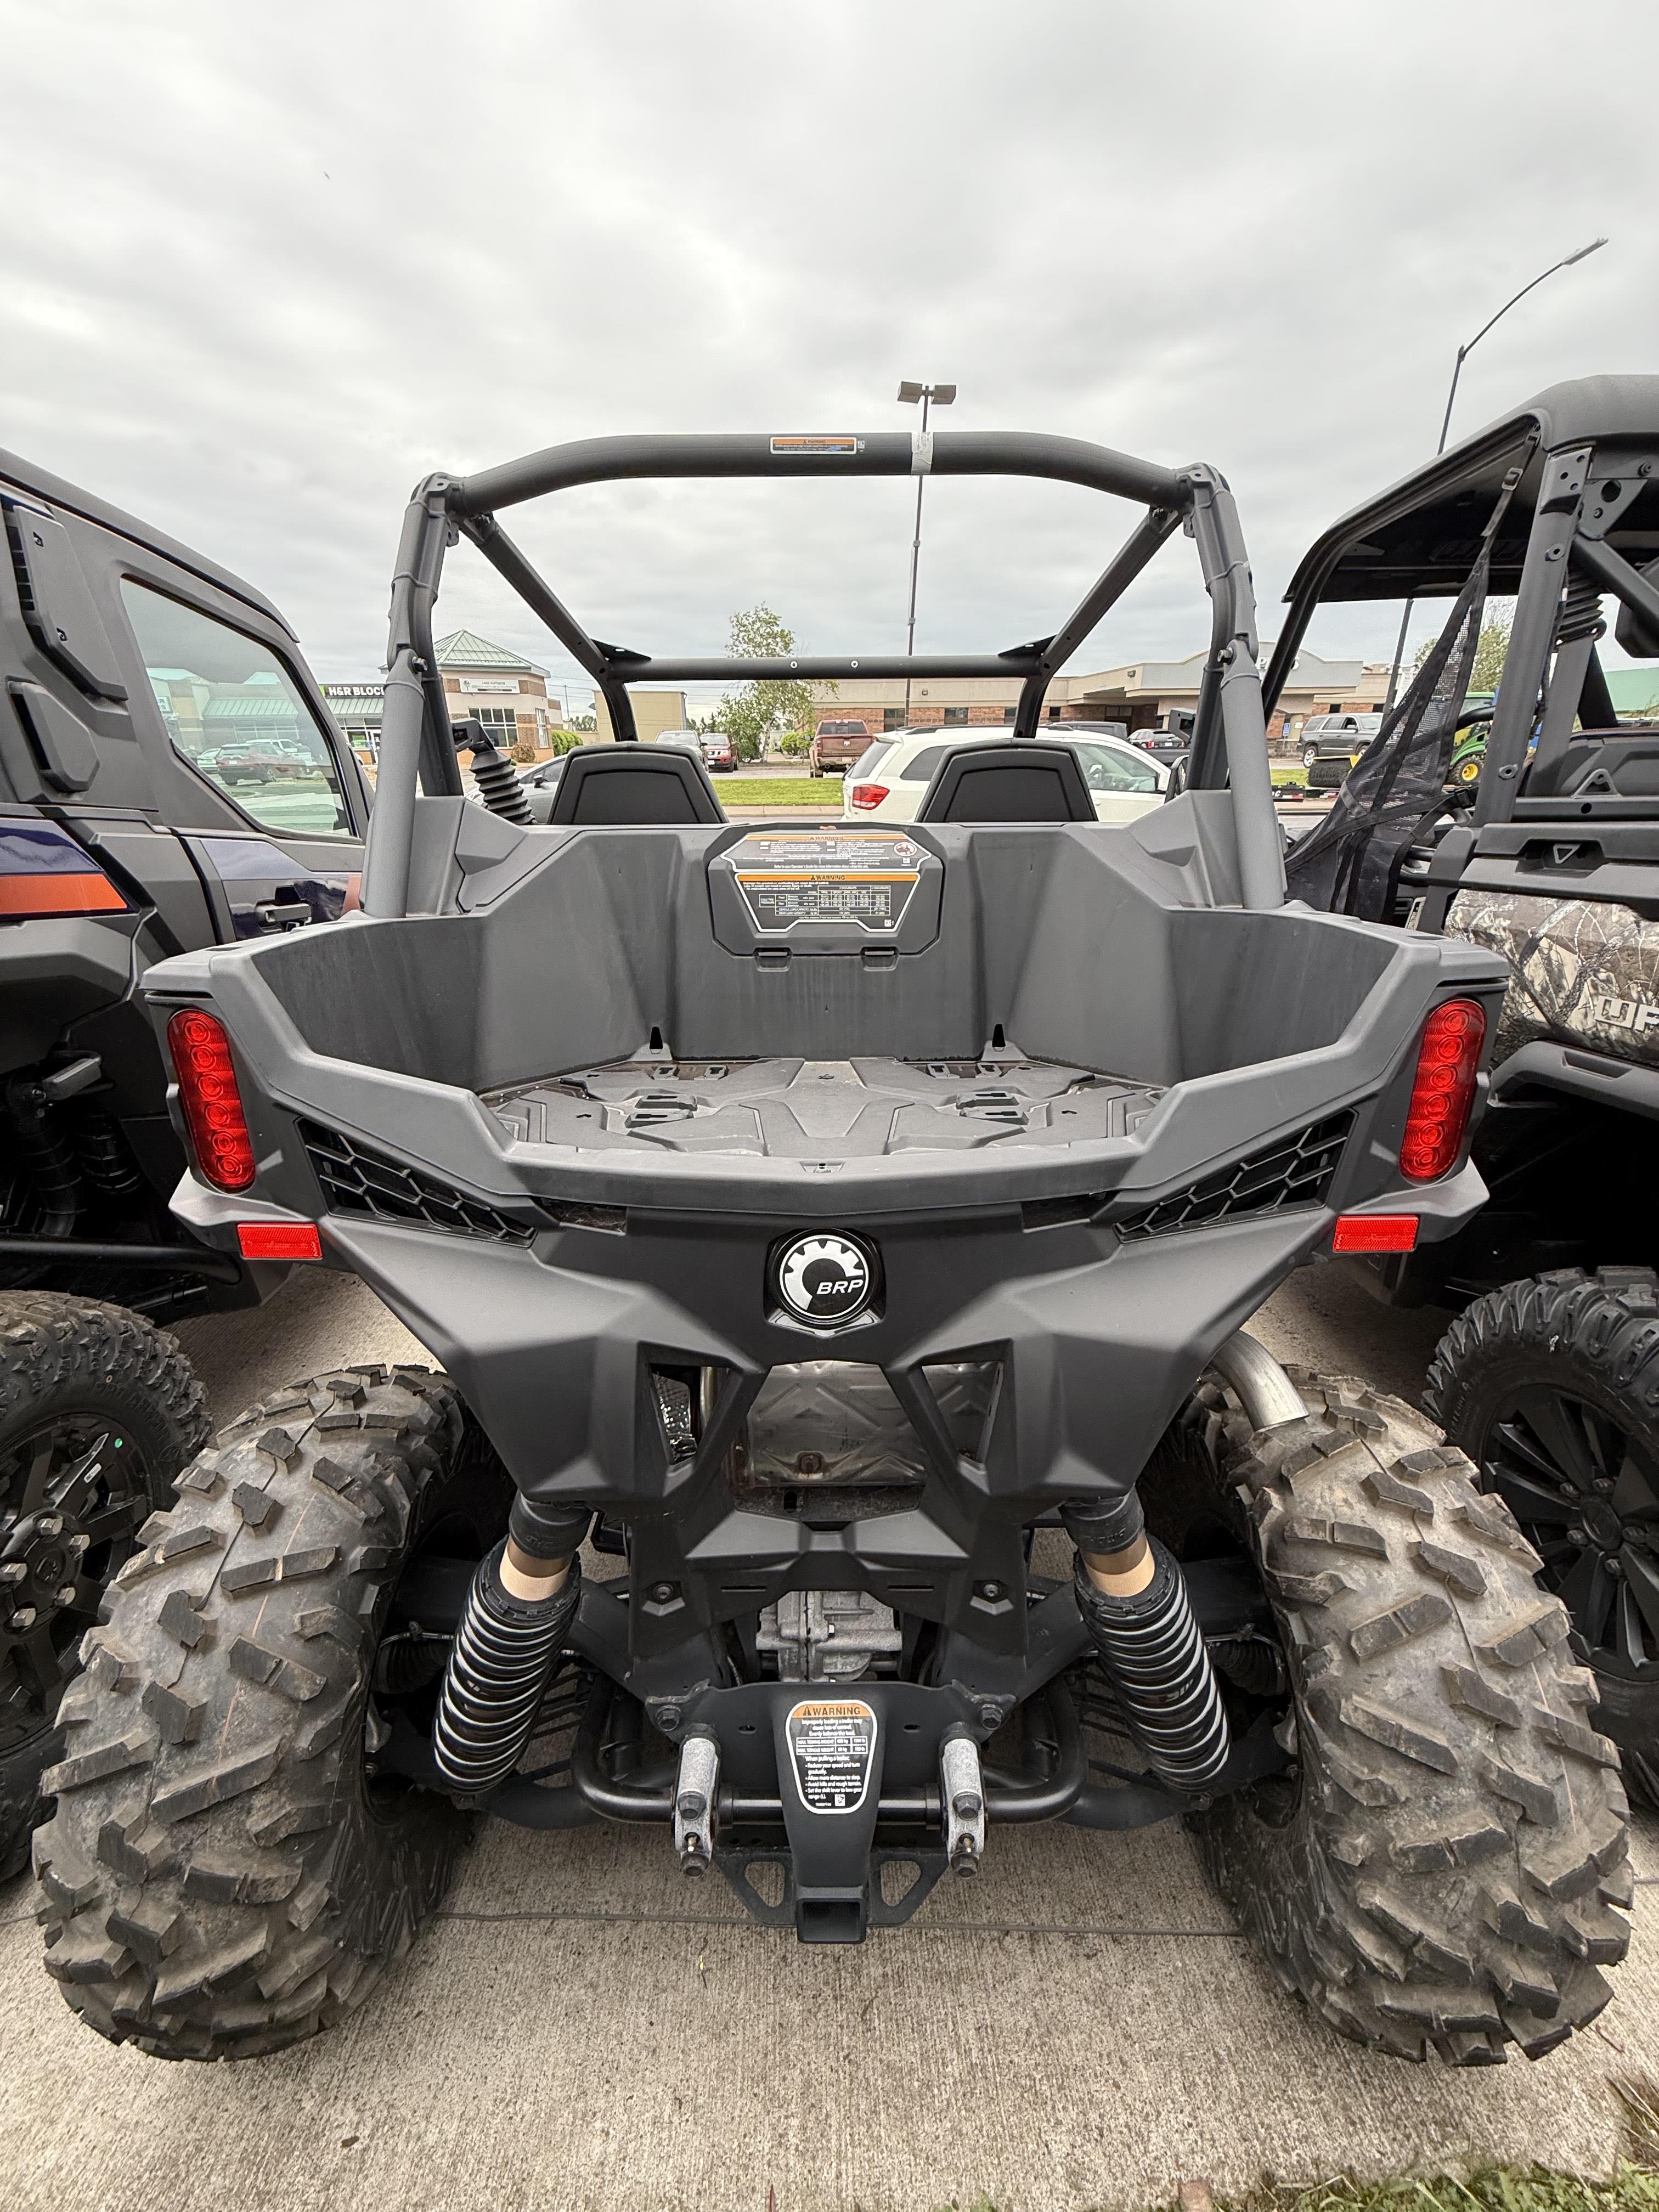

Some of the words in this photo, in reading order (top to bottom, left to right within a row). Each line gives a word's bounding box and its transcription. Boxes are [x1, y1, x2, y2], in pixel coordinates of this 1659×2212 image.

[328, 687, 352, 696] H&R
[816, 1279, 863, 1295] BRP
[812, 1707, 861, 1716] WARNING
